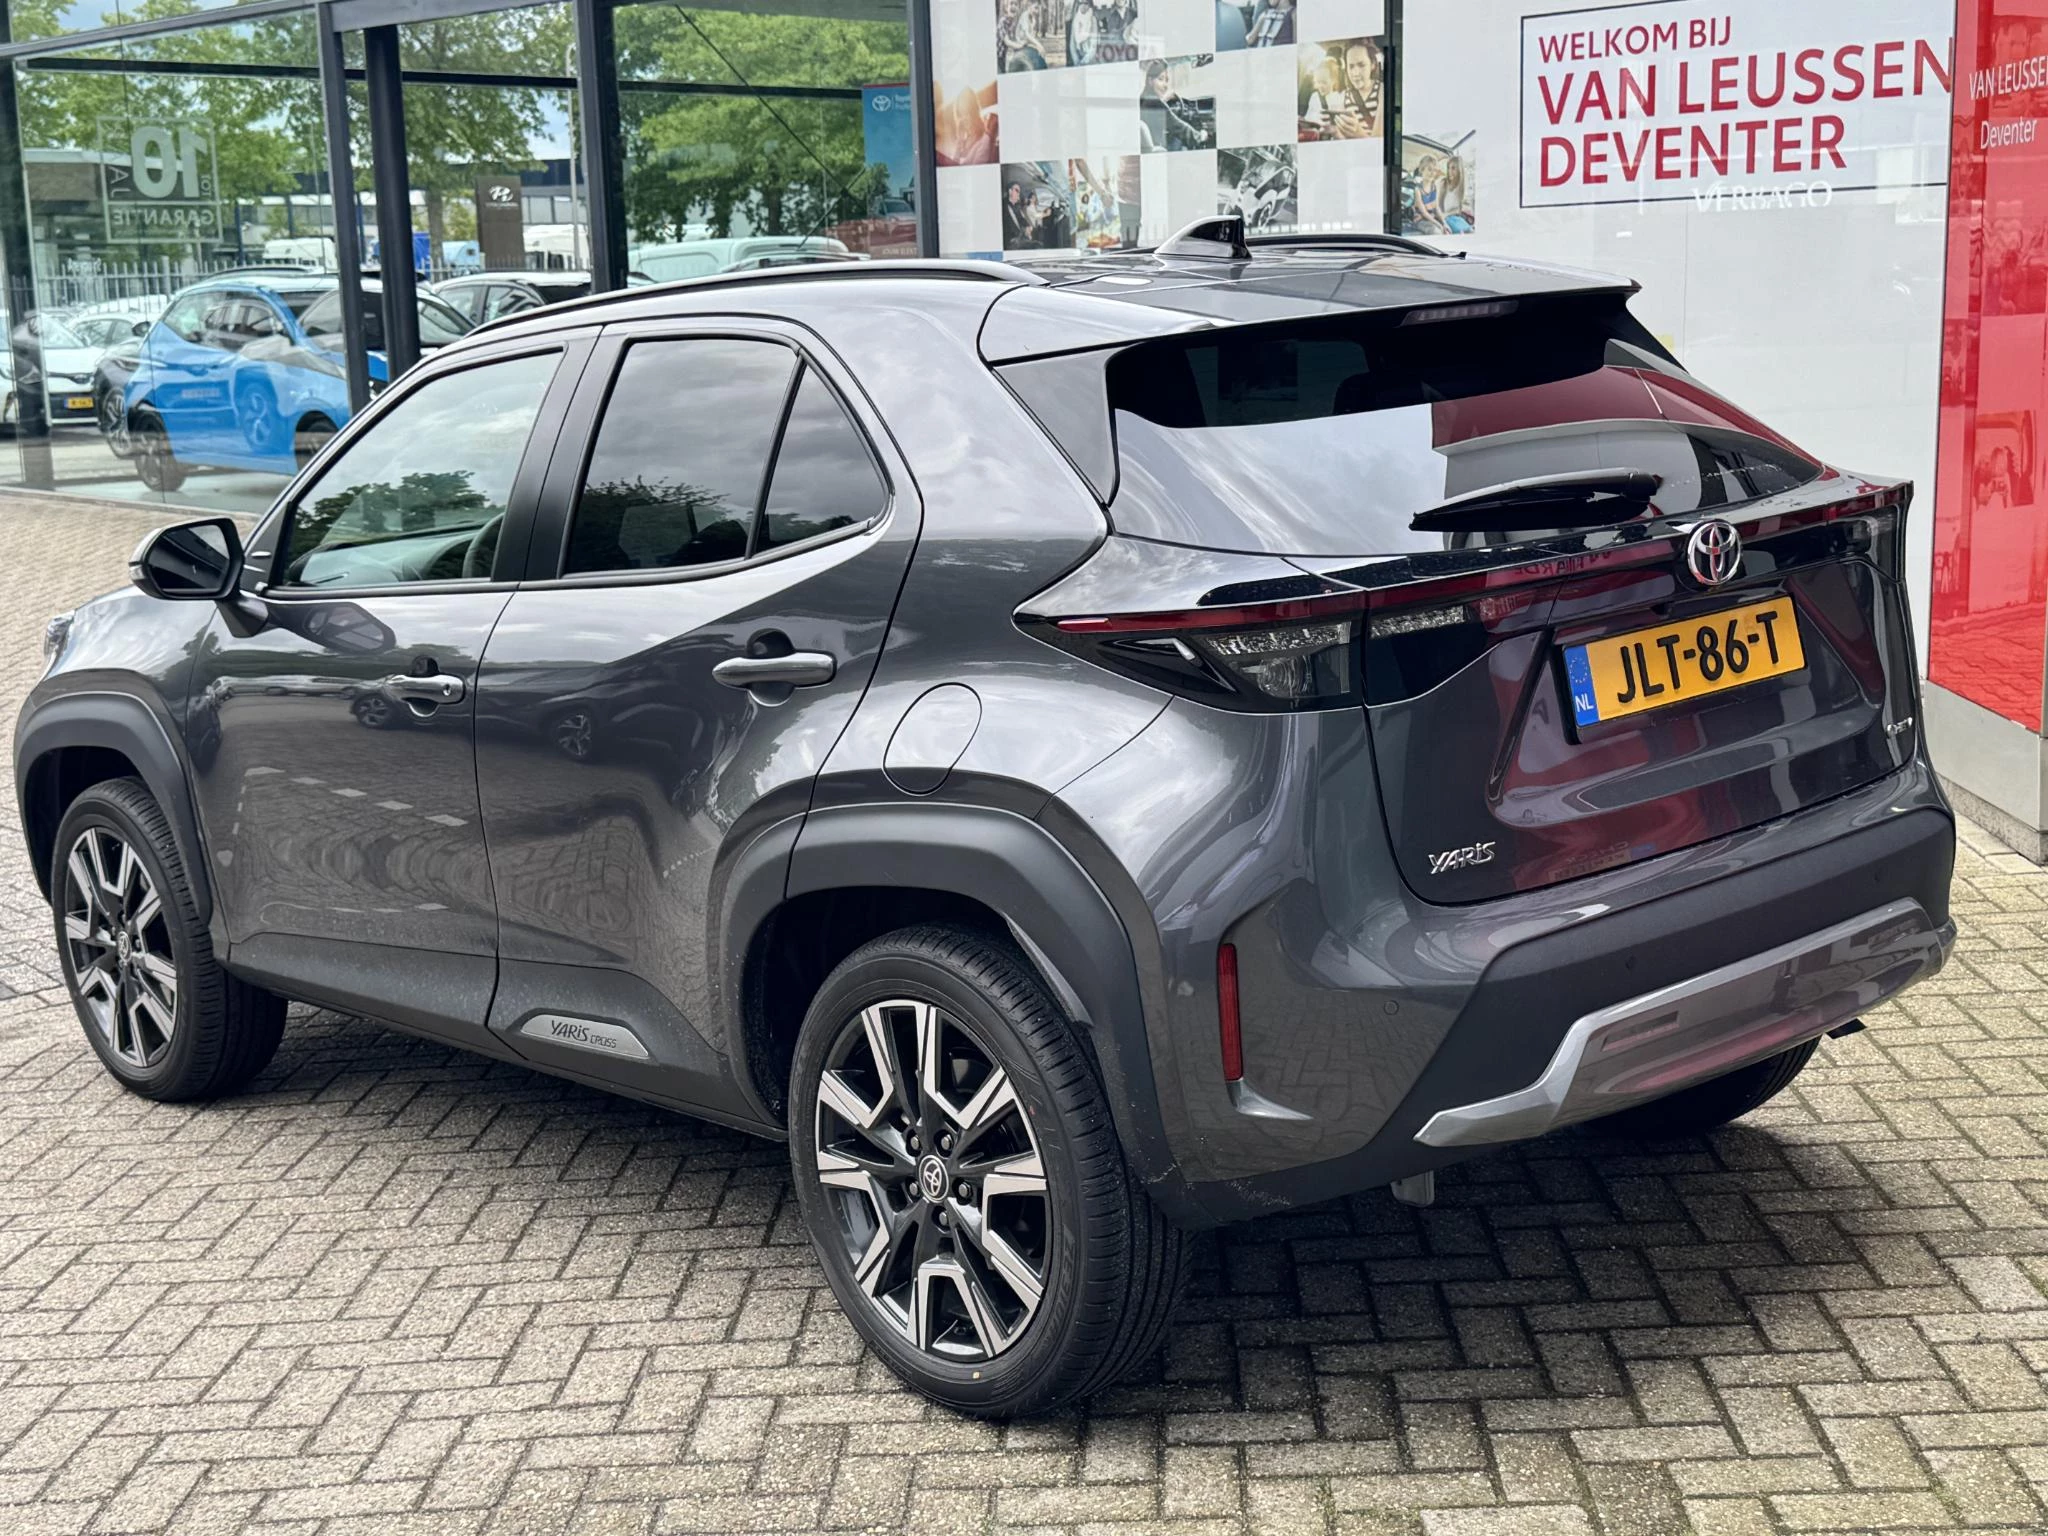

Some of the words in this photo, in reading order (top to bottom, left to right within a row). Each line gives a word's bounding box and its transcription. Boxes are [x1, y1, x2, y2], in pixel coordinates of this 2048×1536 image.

[1538, 21, 1678, 64] WELKOM
[1688, 16, 1731, 48] BIJ
[1538, 64, 1656, 125] VAN
[1678, 36, 1953, 114] LEUSSEN
[1969, 67, 1995, 100] VAN
[1998, 55, 2048, 95] LEUSSE
[1540, 115, 1847, 187] DEVENTER
[1981, 116, 2037, 149] Deventer
[1617, 610, 1778, 704] JLT-86-T
[1574, 695, 1594, 713] NL
[590, 1034, 617, 1049] CROSS
